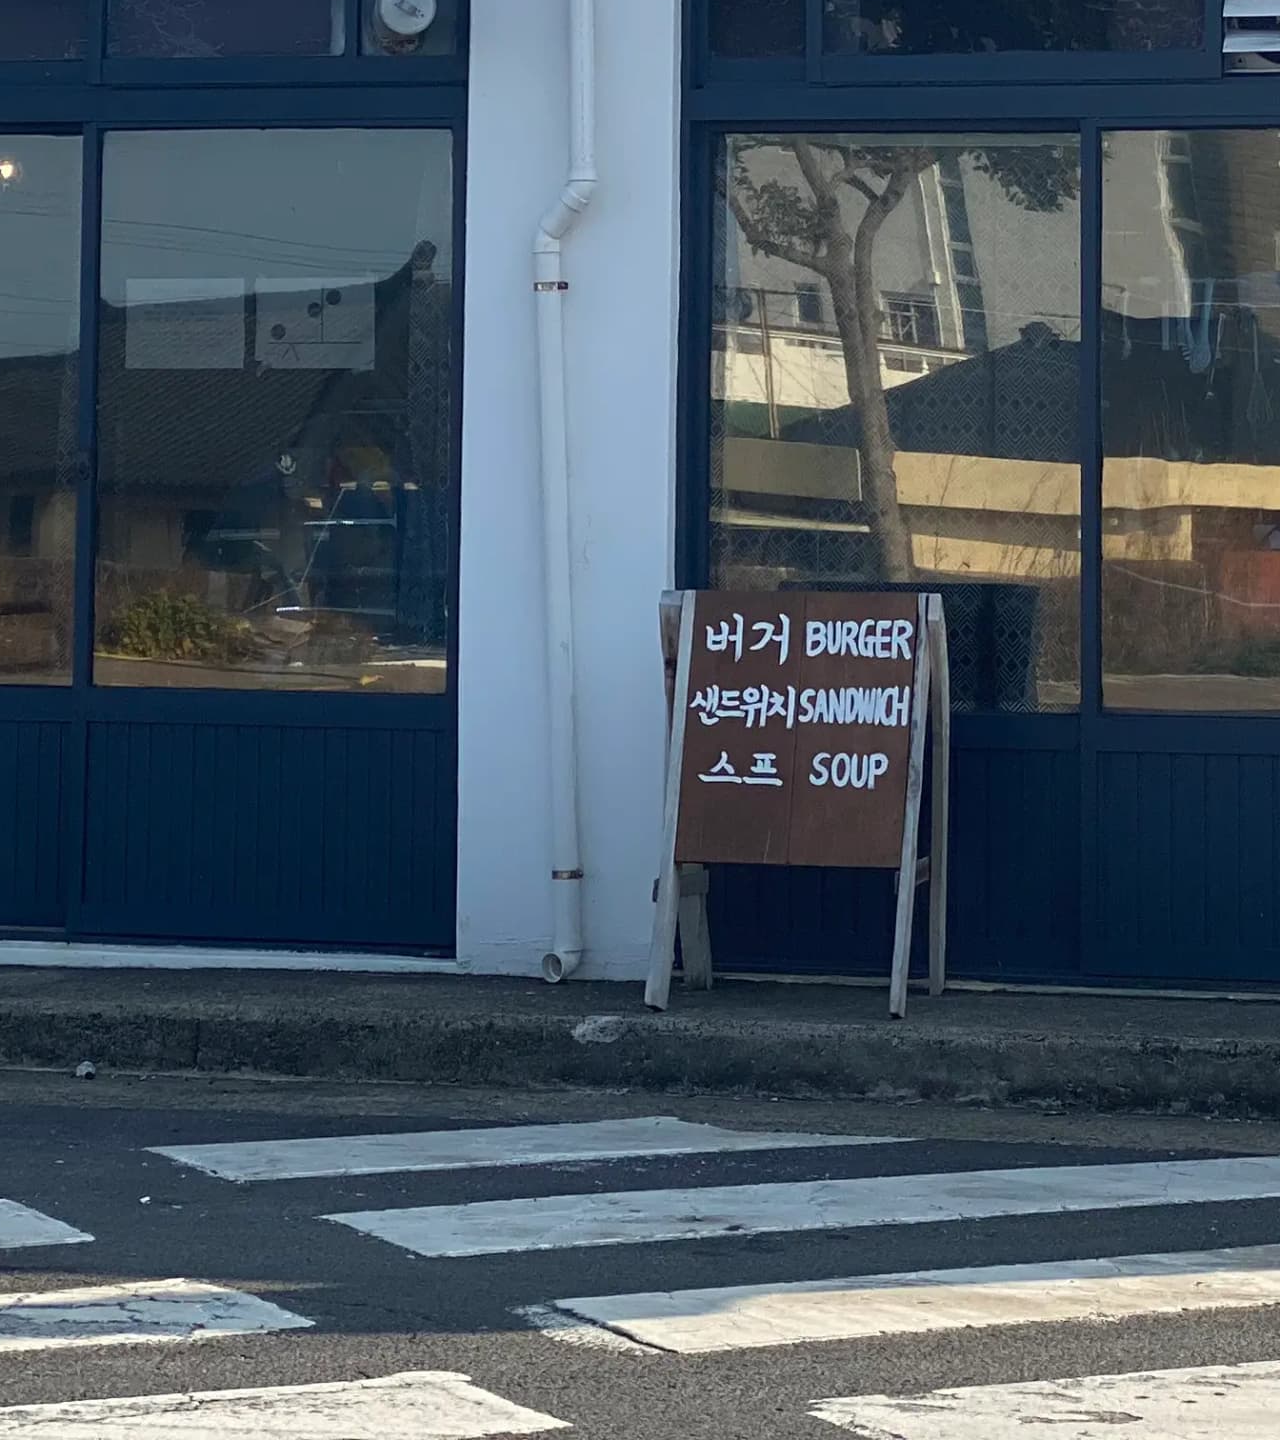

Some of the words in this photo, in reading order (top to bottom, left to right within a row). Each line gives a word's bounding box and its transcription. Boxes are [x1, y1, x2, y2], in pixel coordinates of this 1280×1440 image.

[705, 613, 790, 665] 버거
[806, 618, 913, 661] BURGER
[689, 684, 796, 729] 샌드위치
[798, 685, 910, 727] SANDWICH
[697, 751, 783, 787] 스프
[809, 753, 889, 789] SOUP
